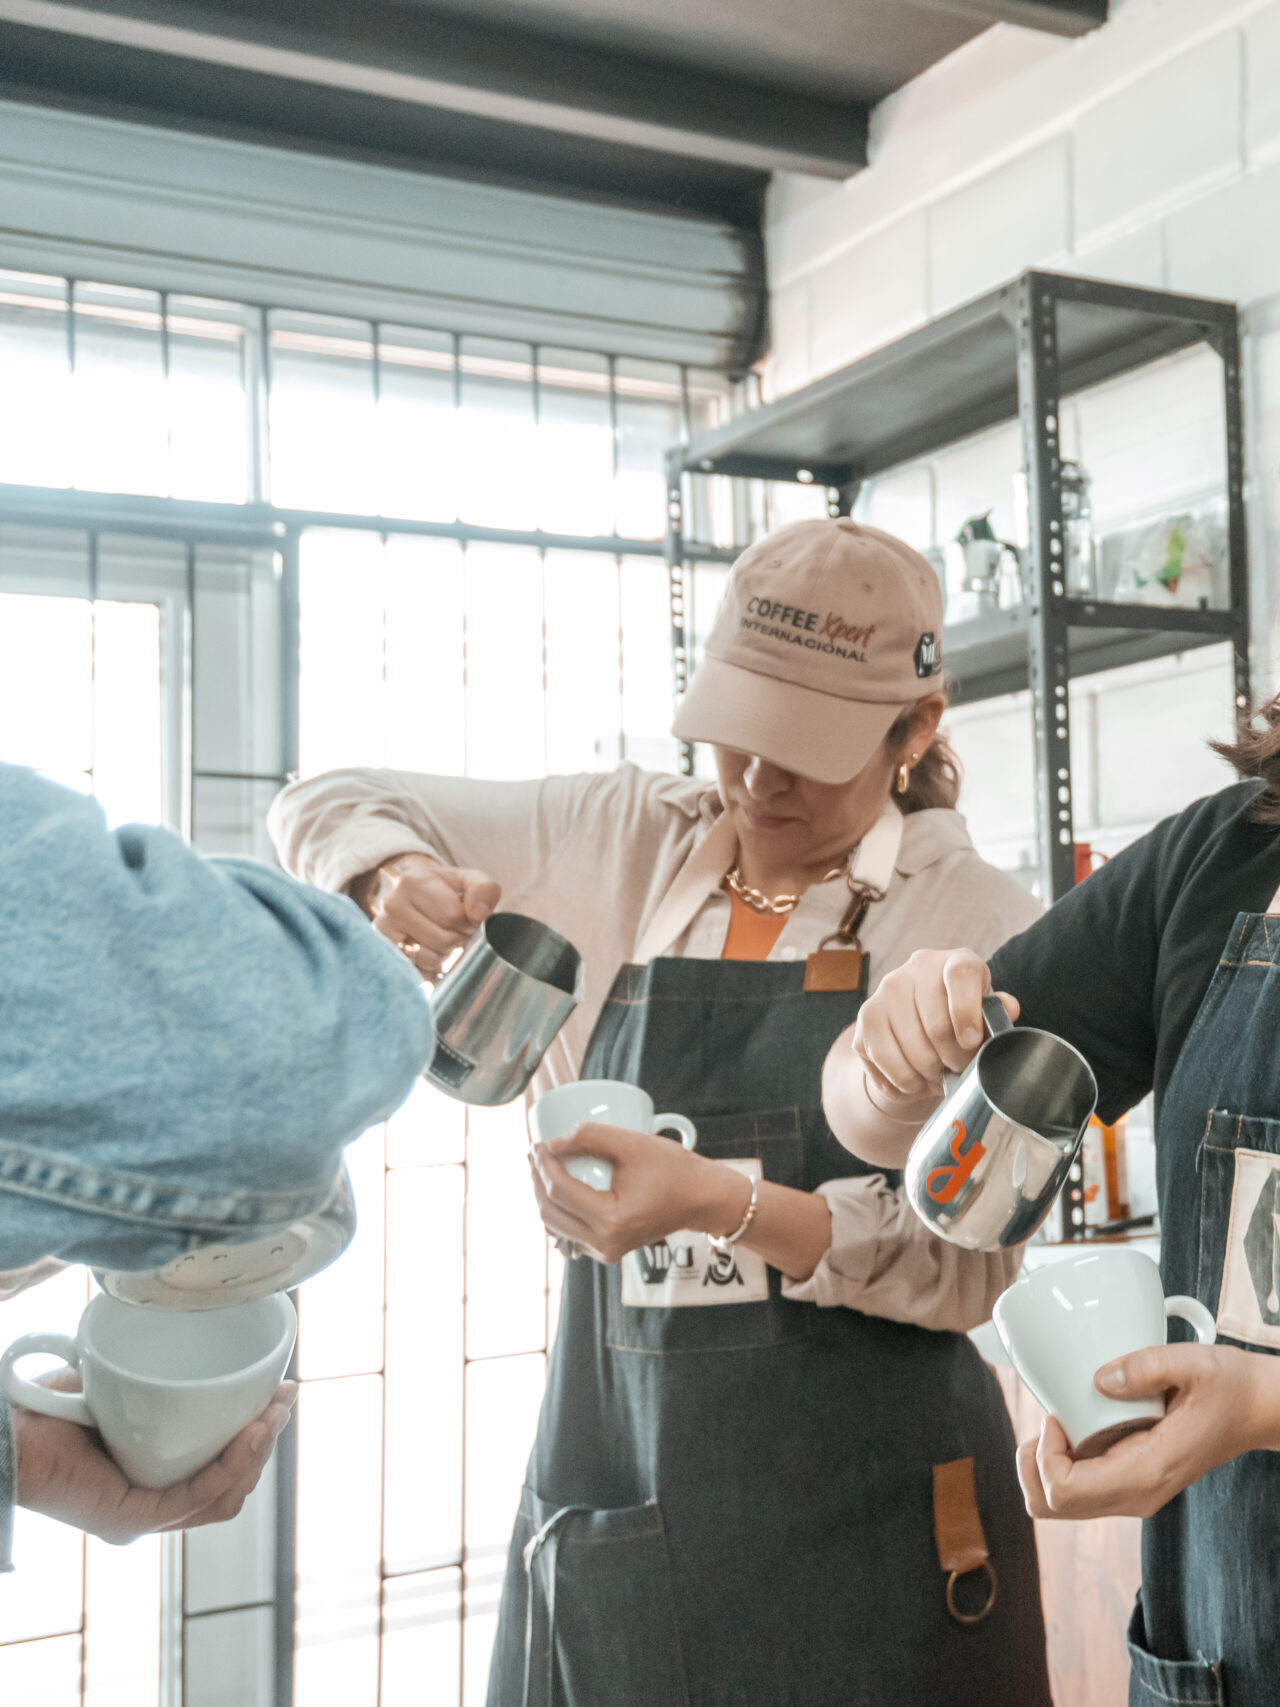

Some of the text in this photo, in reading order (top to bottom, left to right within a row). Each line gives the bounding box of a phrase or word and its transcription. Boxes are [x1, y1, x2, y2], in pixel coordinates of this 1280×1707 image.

[741, 617, 868, 662] INTERNACIONAL
[746, 596, 876, 648] COFFEE Xpert
